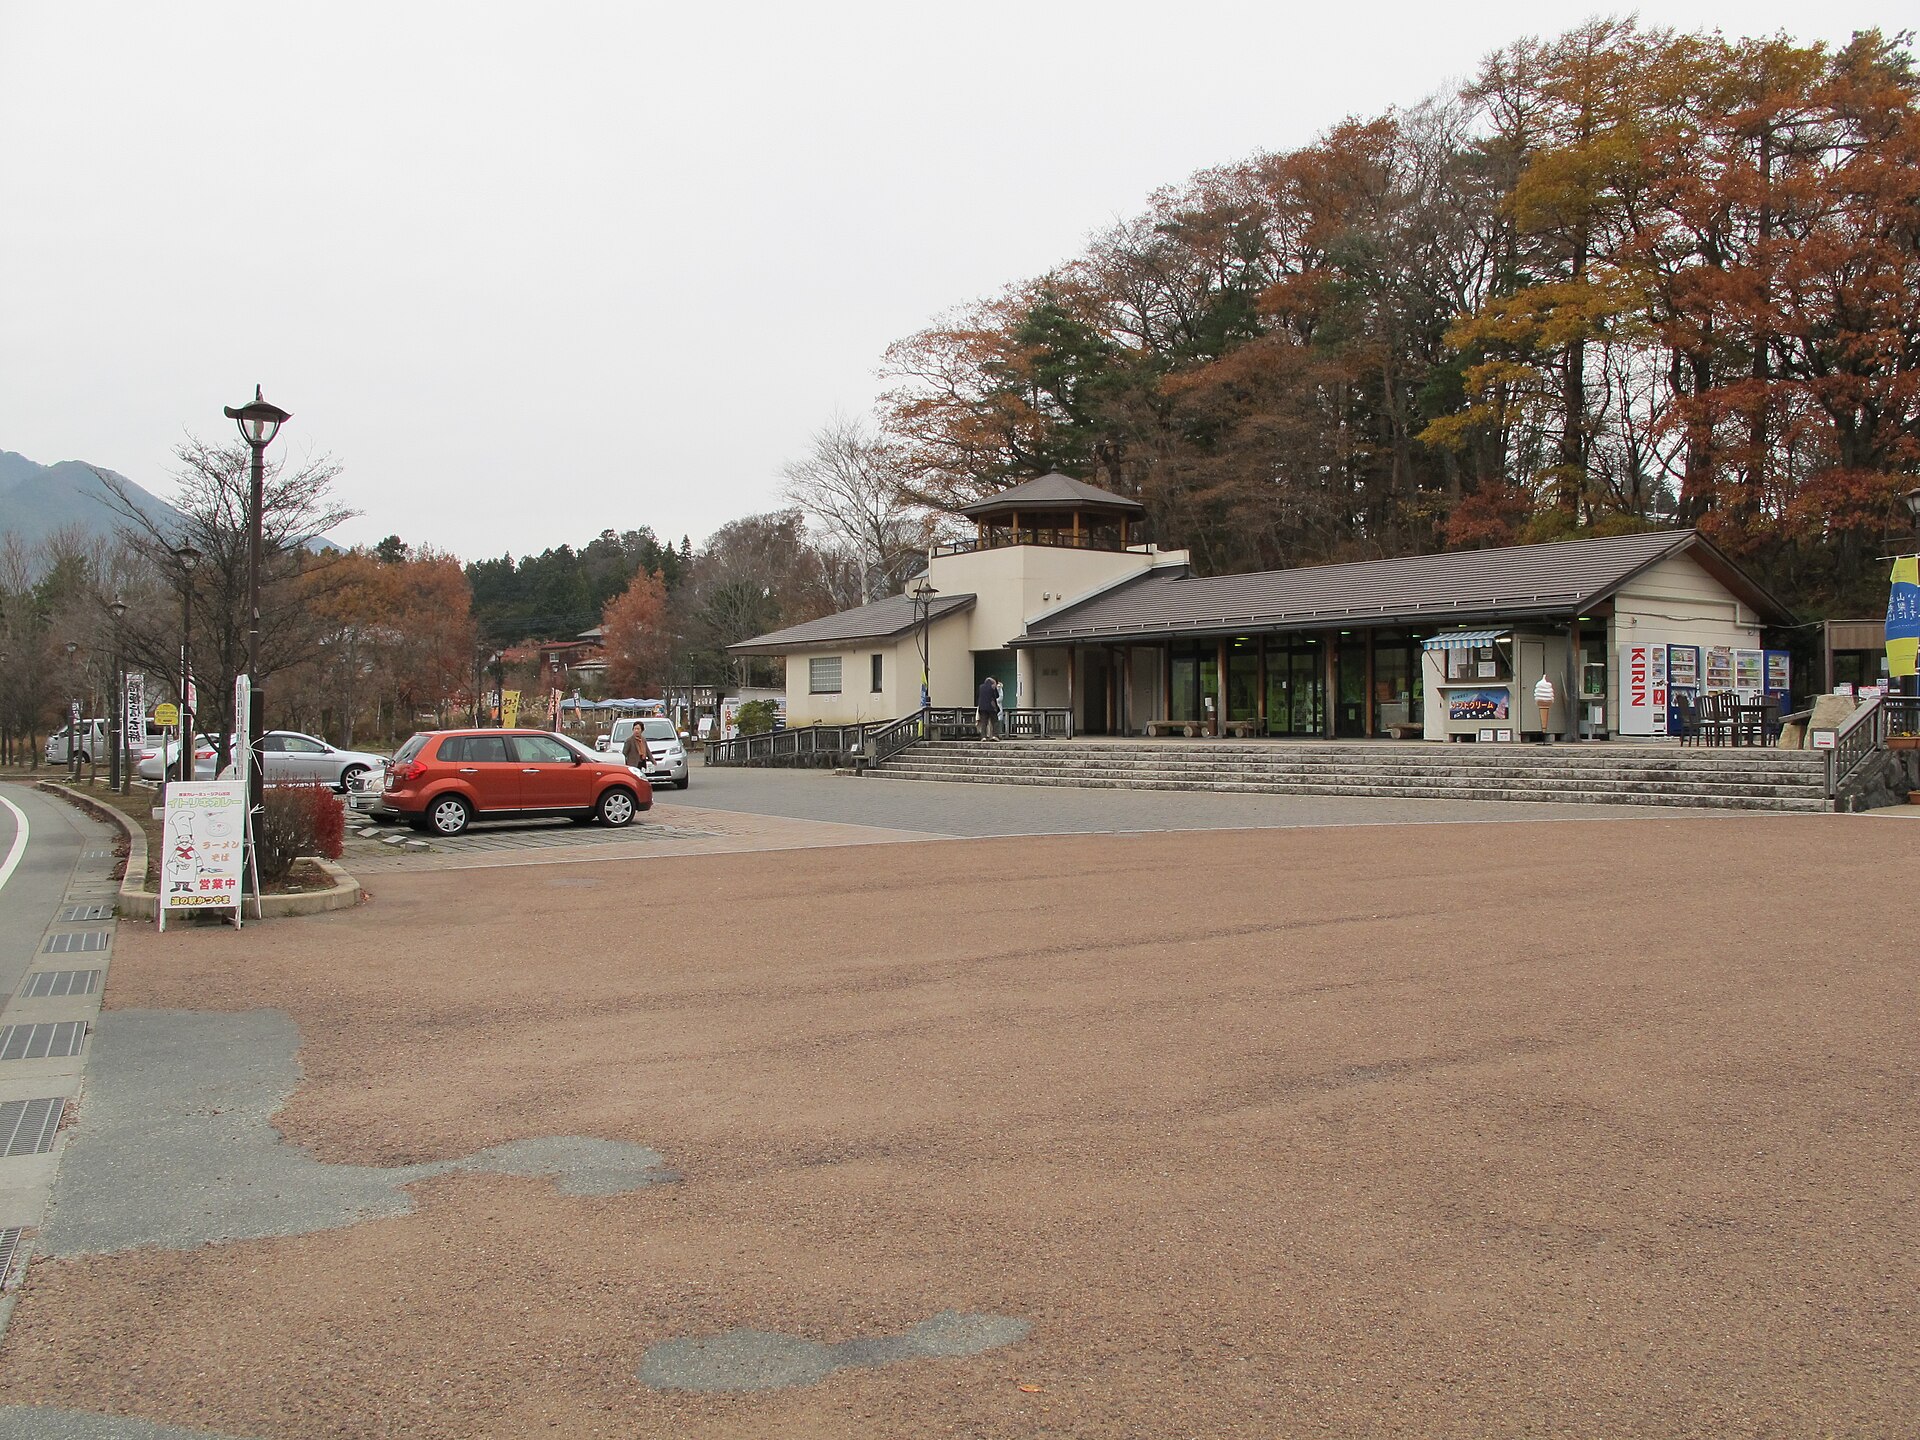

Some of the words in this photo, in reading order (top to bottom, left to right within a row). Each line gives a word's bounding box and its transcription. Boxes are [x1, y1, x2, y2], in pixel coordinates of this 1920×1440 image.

[1631, 648, 1646, 706] KIRIN
[202, 841, 239, 850] ラーメン
[211, 853, 229, 862] そば
[199, 878, 236, 890] 営業中
[170, 895, 231, 906] 道の駅かつやま
